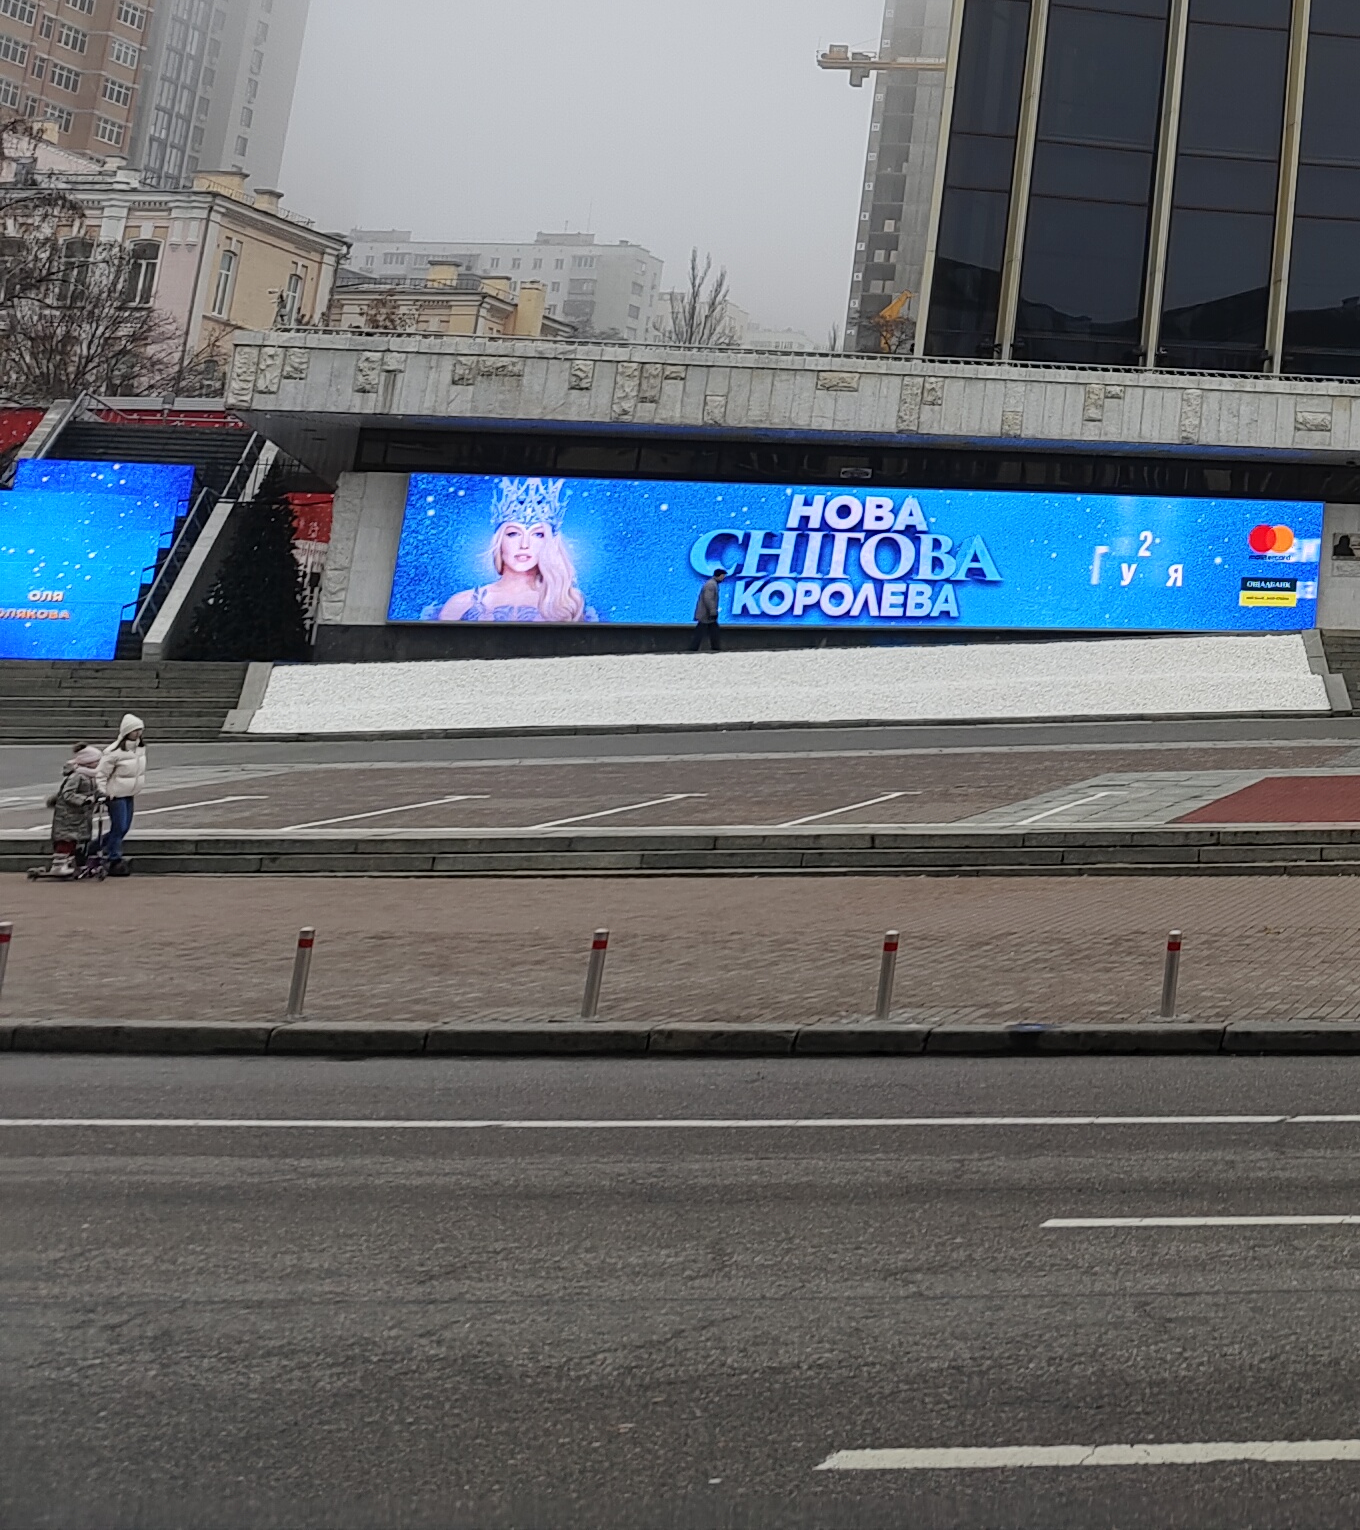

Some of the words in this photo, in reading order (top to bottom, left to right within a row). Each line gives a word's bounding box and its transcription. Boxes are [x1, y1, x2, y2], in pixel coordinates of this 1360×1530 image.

[786, 494, 928, 531] НОВА
[689, 528, 1004, 581] СНІГОВА
[28, 590, 64, 602] ОЛЯ
[731, 580, 960, 618] КОРОЛЕВА
